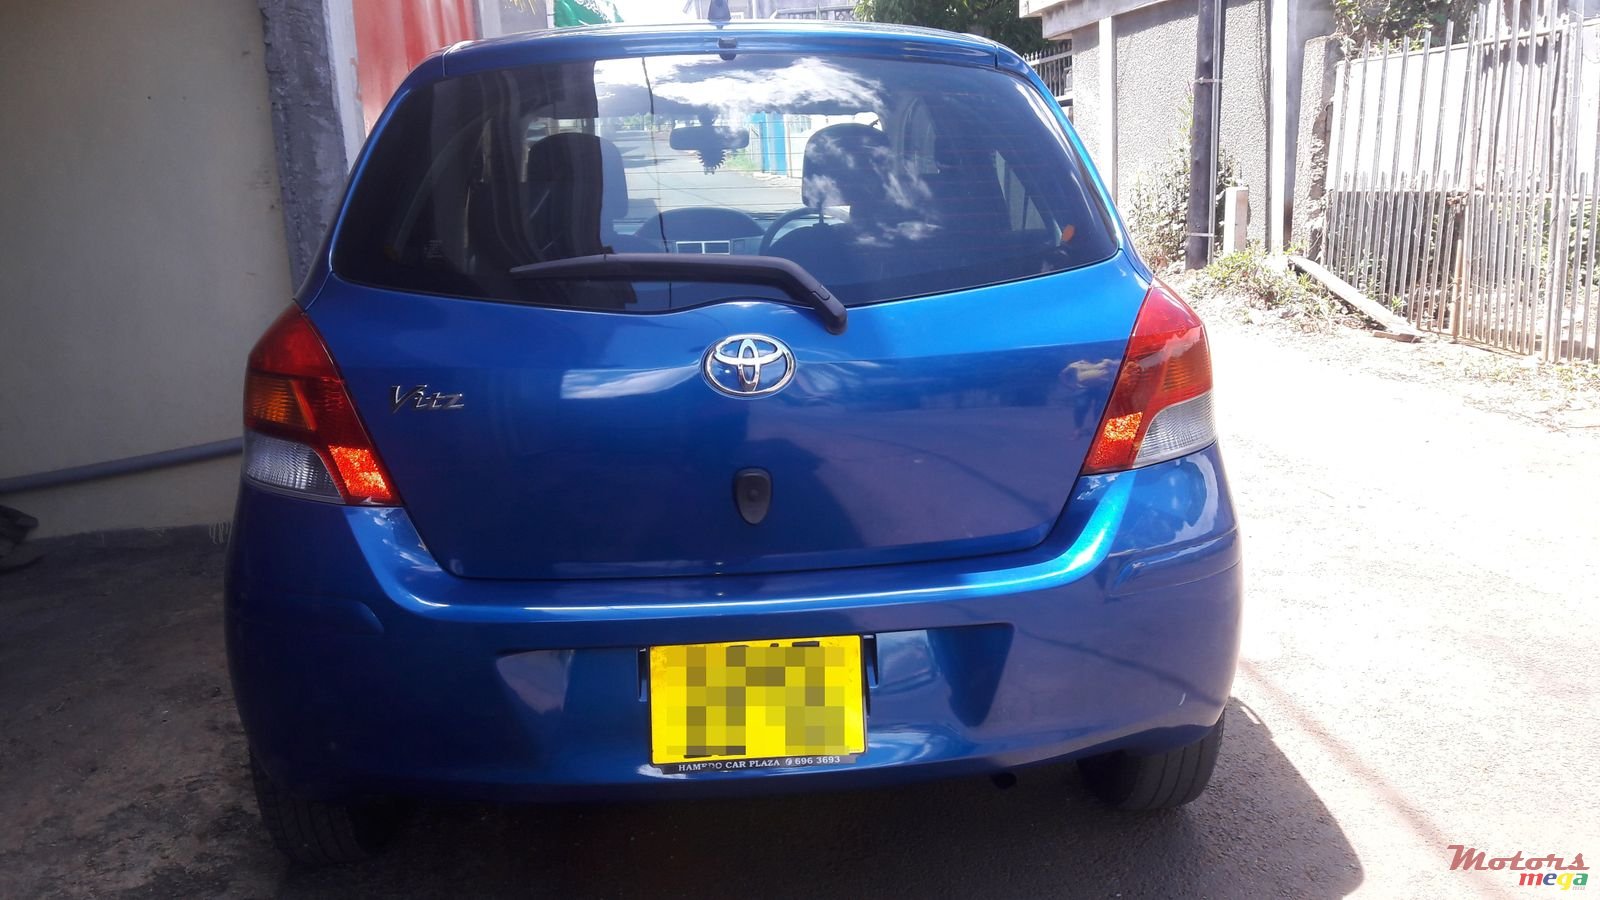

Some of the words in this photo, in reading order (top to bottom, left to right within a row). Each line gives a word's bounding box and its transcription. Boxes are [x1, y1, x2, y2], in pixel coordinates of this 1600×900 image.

[391, 384, 465, 413] Vitz
[725, 759, 746, 769] CAR
[749, 758, 780, 768] PLAZA
[794, 756, 813, 765] 696
[816, 755, 841, 764] 3693
